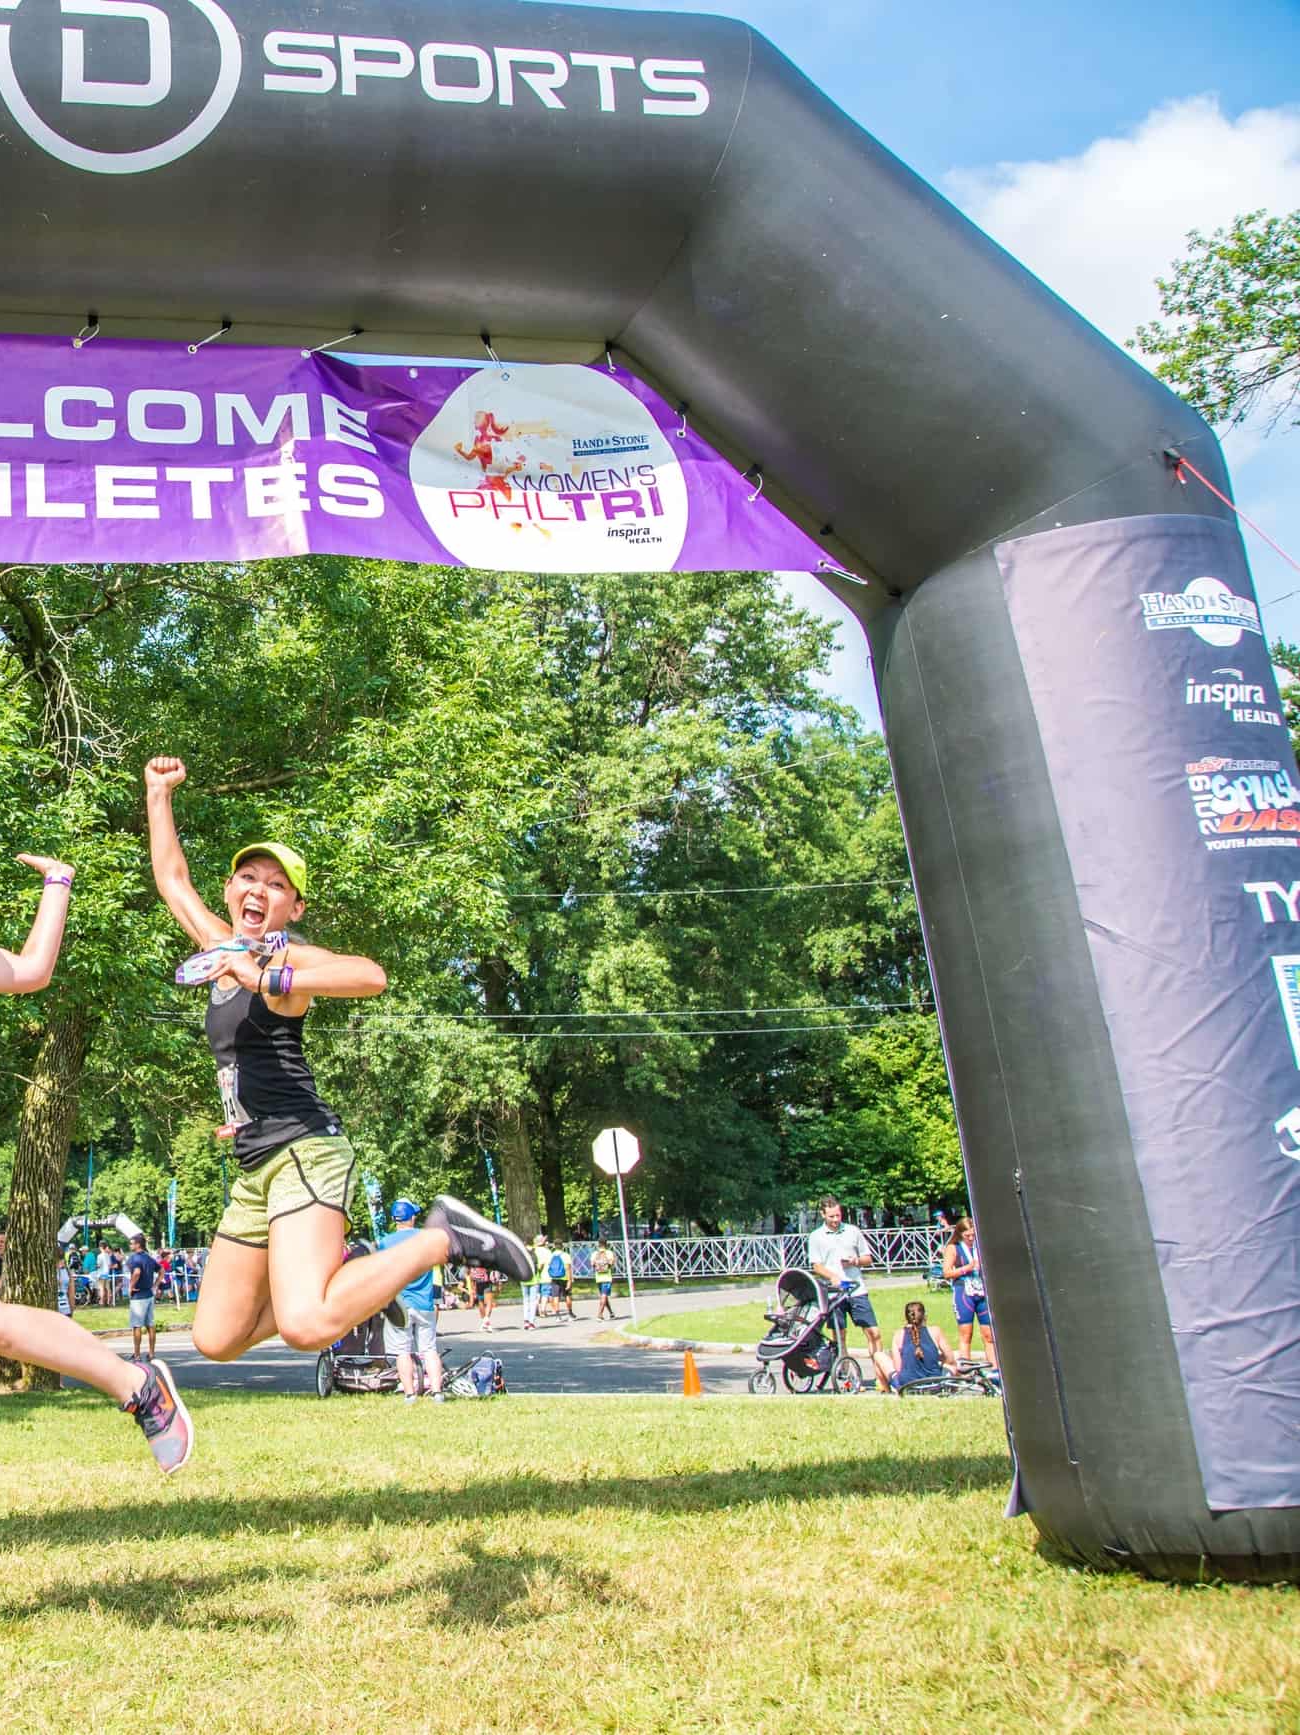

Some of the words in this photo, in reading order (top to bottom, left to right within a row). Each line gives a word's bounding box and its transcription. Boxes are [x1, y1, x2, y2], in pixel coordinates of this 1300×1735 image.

[263, 31, 710, 116] SPORTS
[572, 439, 604, 449] HAND
[612, 434, 648, 446] STONE
[513, 464, 657, 492] WOMEN'S
[607, 525, 651, 540] inspira
[628, 535, 663, 545] HEALTH
[1141, 592, 1205, 613] HAND
[1186, 678, 1267, 711] inspira
